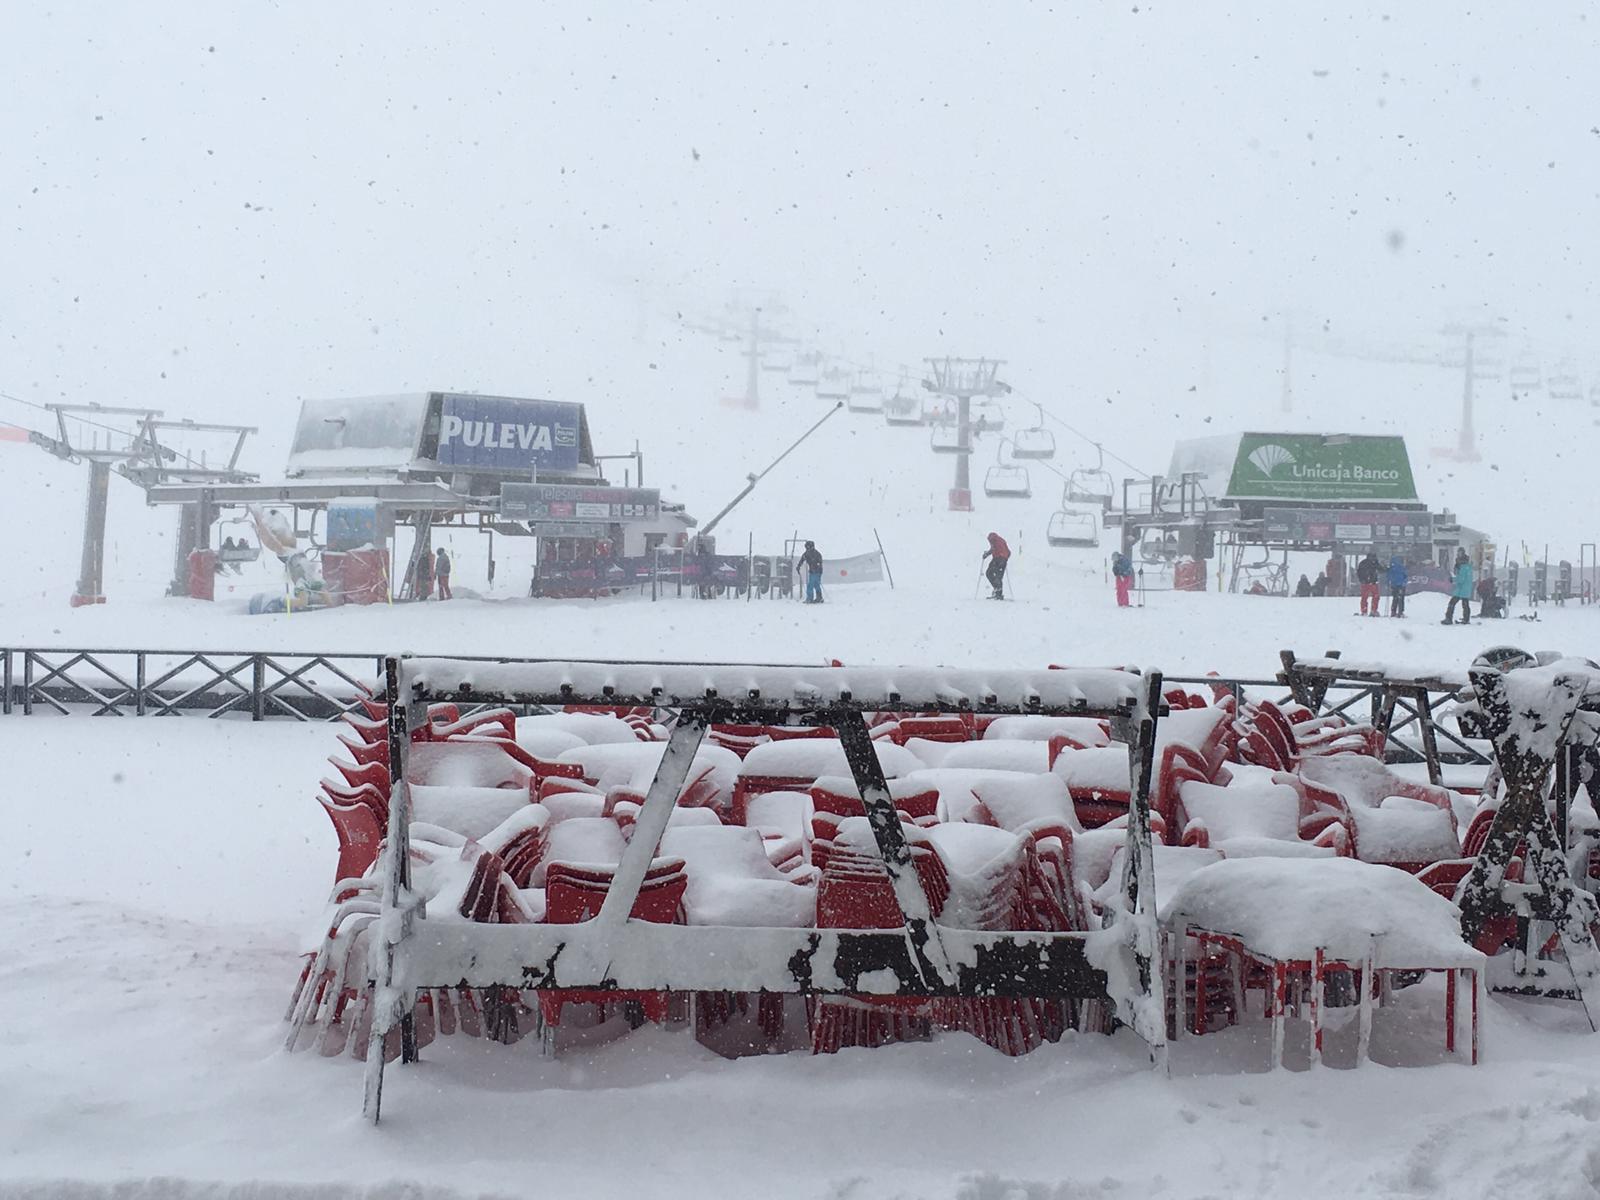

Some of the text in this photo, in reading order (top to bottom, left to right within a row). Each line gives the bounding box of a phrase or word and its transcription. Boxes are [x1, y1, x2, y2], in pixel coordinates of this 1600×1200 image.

[439, 415, 553, 451] PULEVA
[1292, 463, 1399, 481] Unicaja Banco
